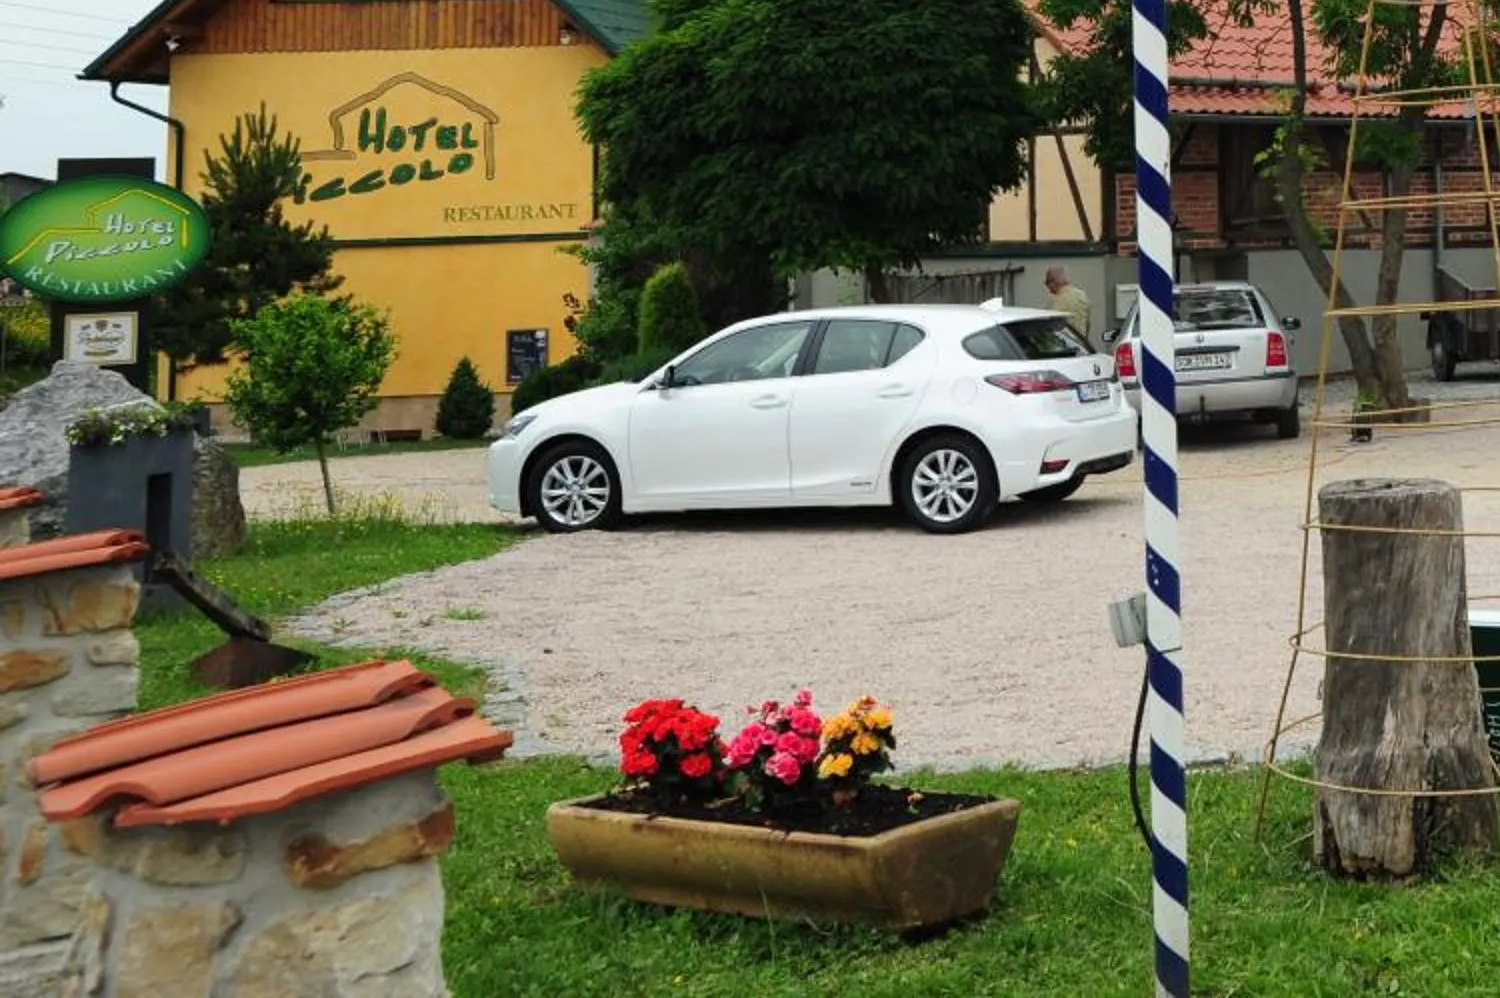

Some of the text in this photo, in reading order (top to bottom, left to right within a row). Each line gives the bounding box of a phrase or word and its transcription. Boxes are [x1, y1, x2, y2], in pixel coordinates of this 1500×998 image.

[357, 106, 479, 154] HOTEL
[291, 152, 474, 205] ICCOLO
[442, 202, 578, 224] RESTAURANT
[24, 258, 187, 296] RESTAURANT
